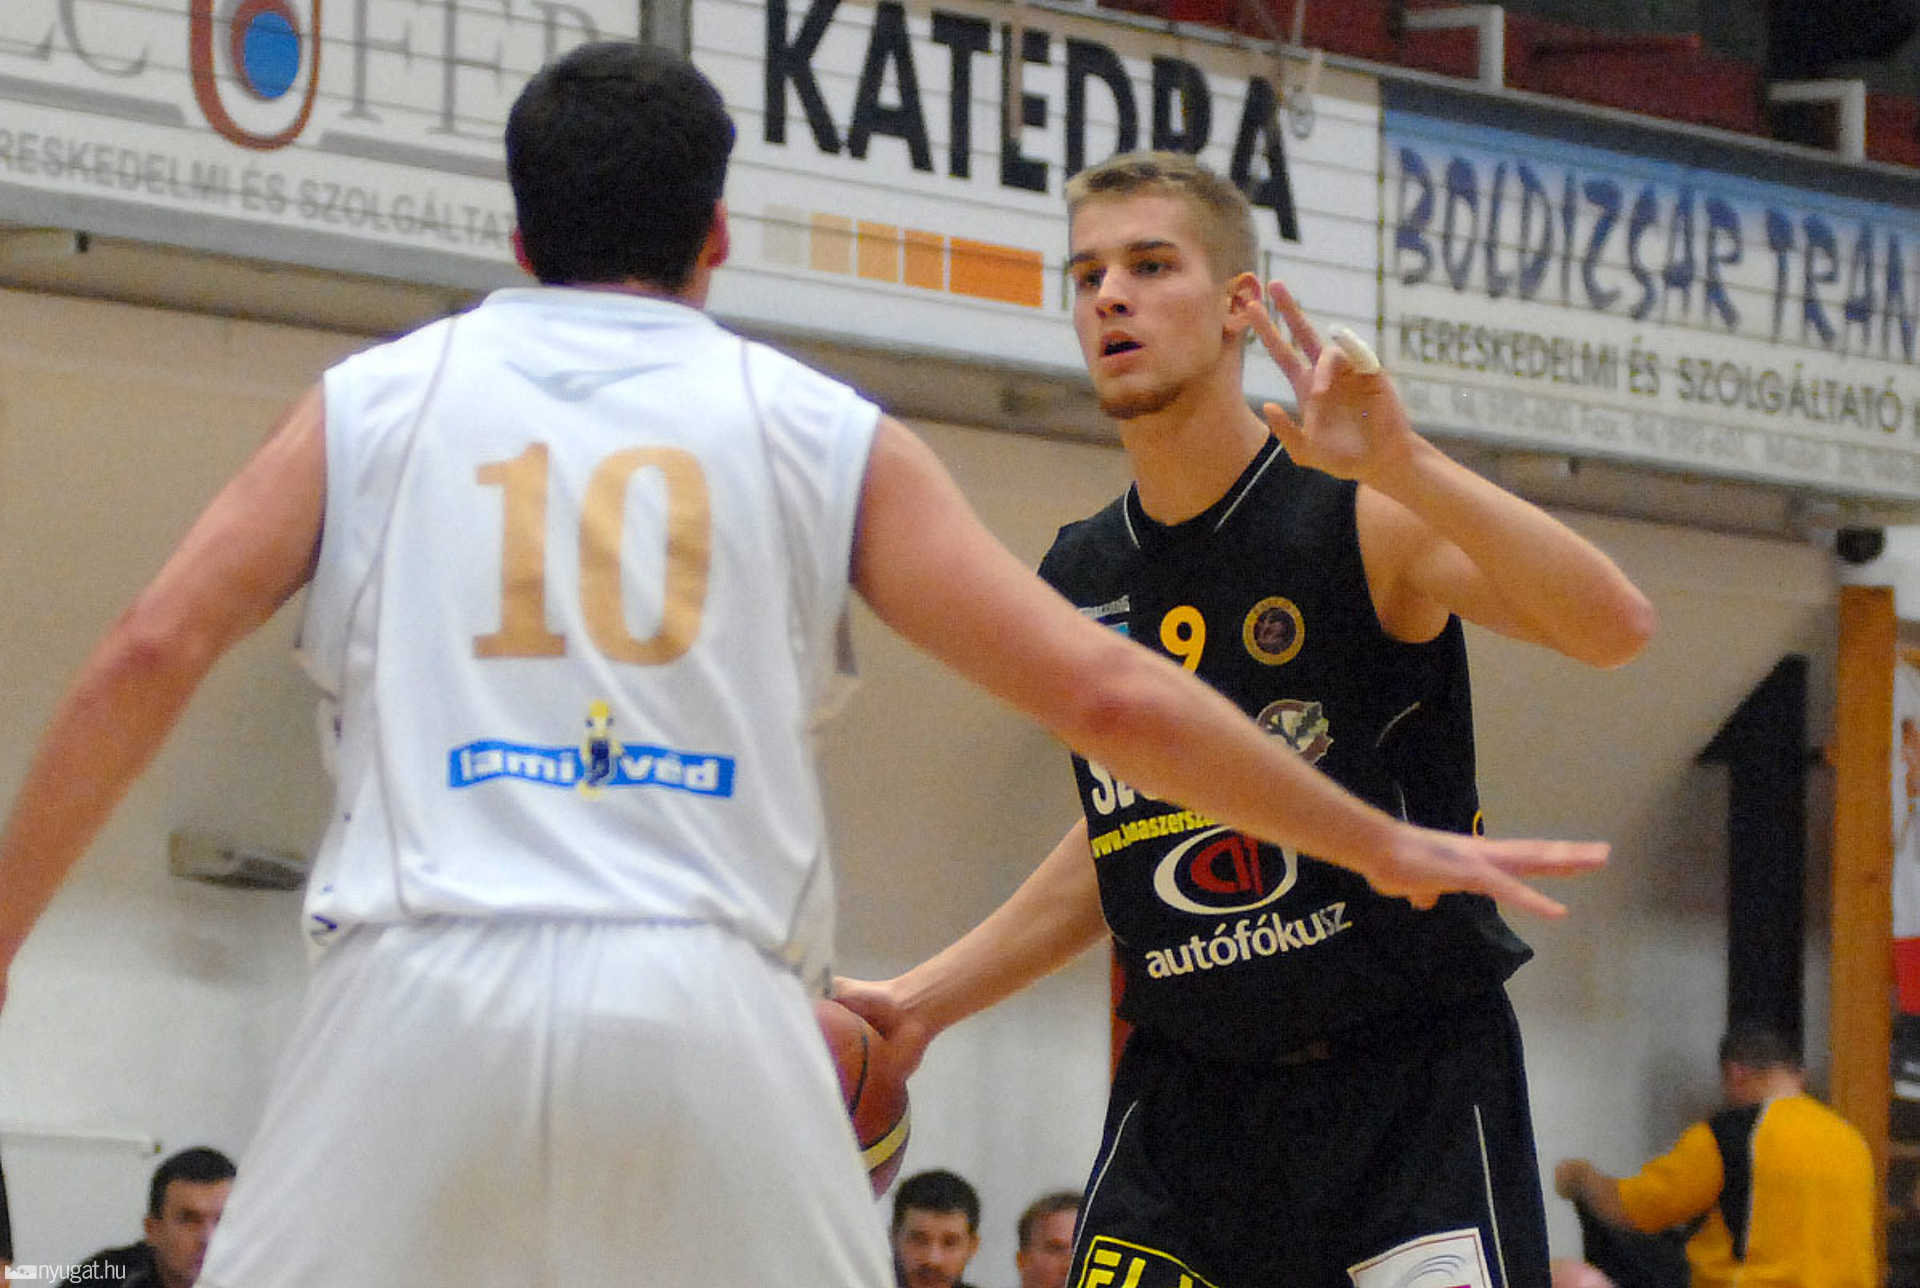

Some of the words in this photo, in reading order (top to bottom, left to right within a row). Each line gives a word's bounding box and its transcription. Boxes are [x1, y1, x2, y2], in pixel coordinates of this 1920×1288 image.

[762, 0, 1301, 242] KATEDRA
[1400, 312, 1618, 392] KERESKEDELMI
[1627, 336, 1661, 397] ÉS
[1677, 355, 1902, 434] SZOLGÁLTATÓ
[472, 440, 712, 667] 10
[1159, 604, 1207, 673] 9
[1144, 901, 1353, 979] autófókusz
